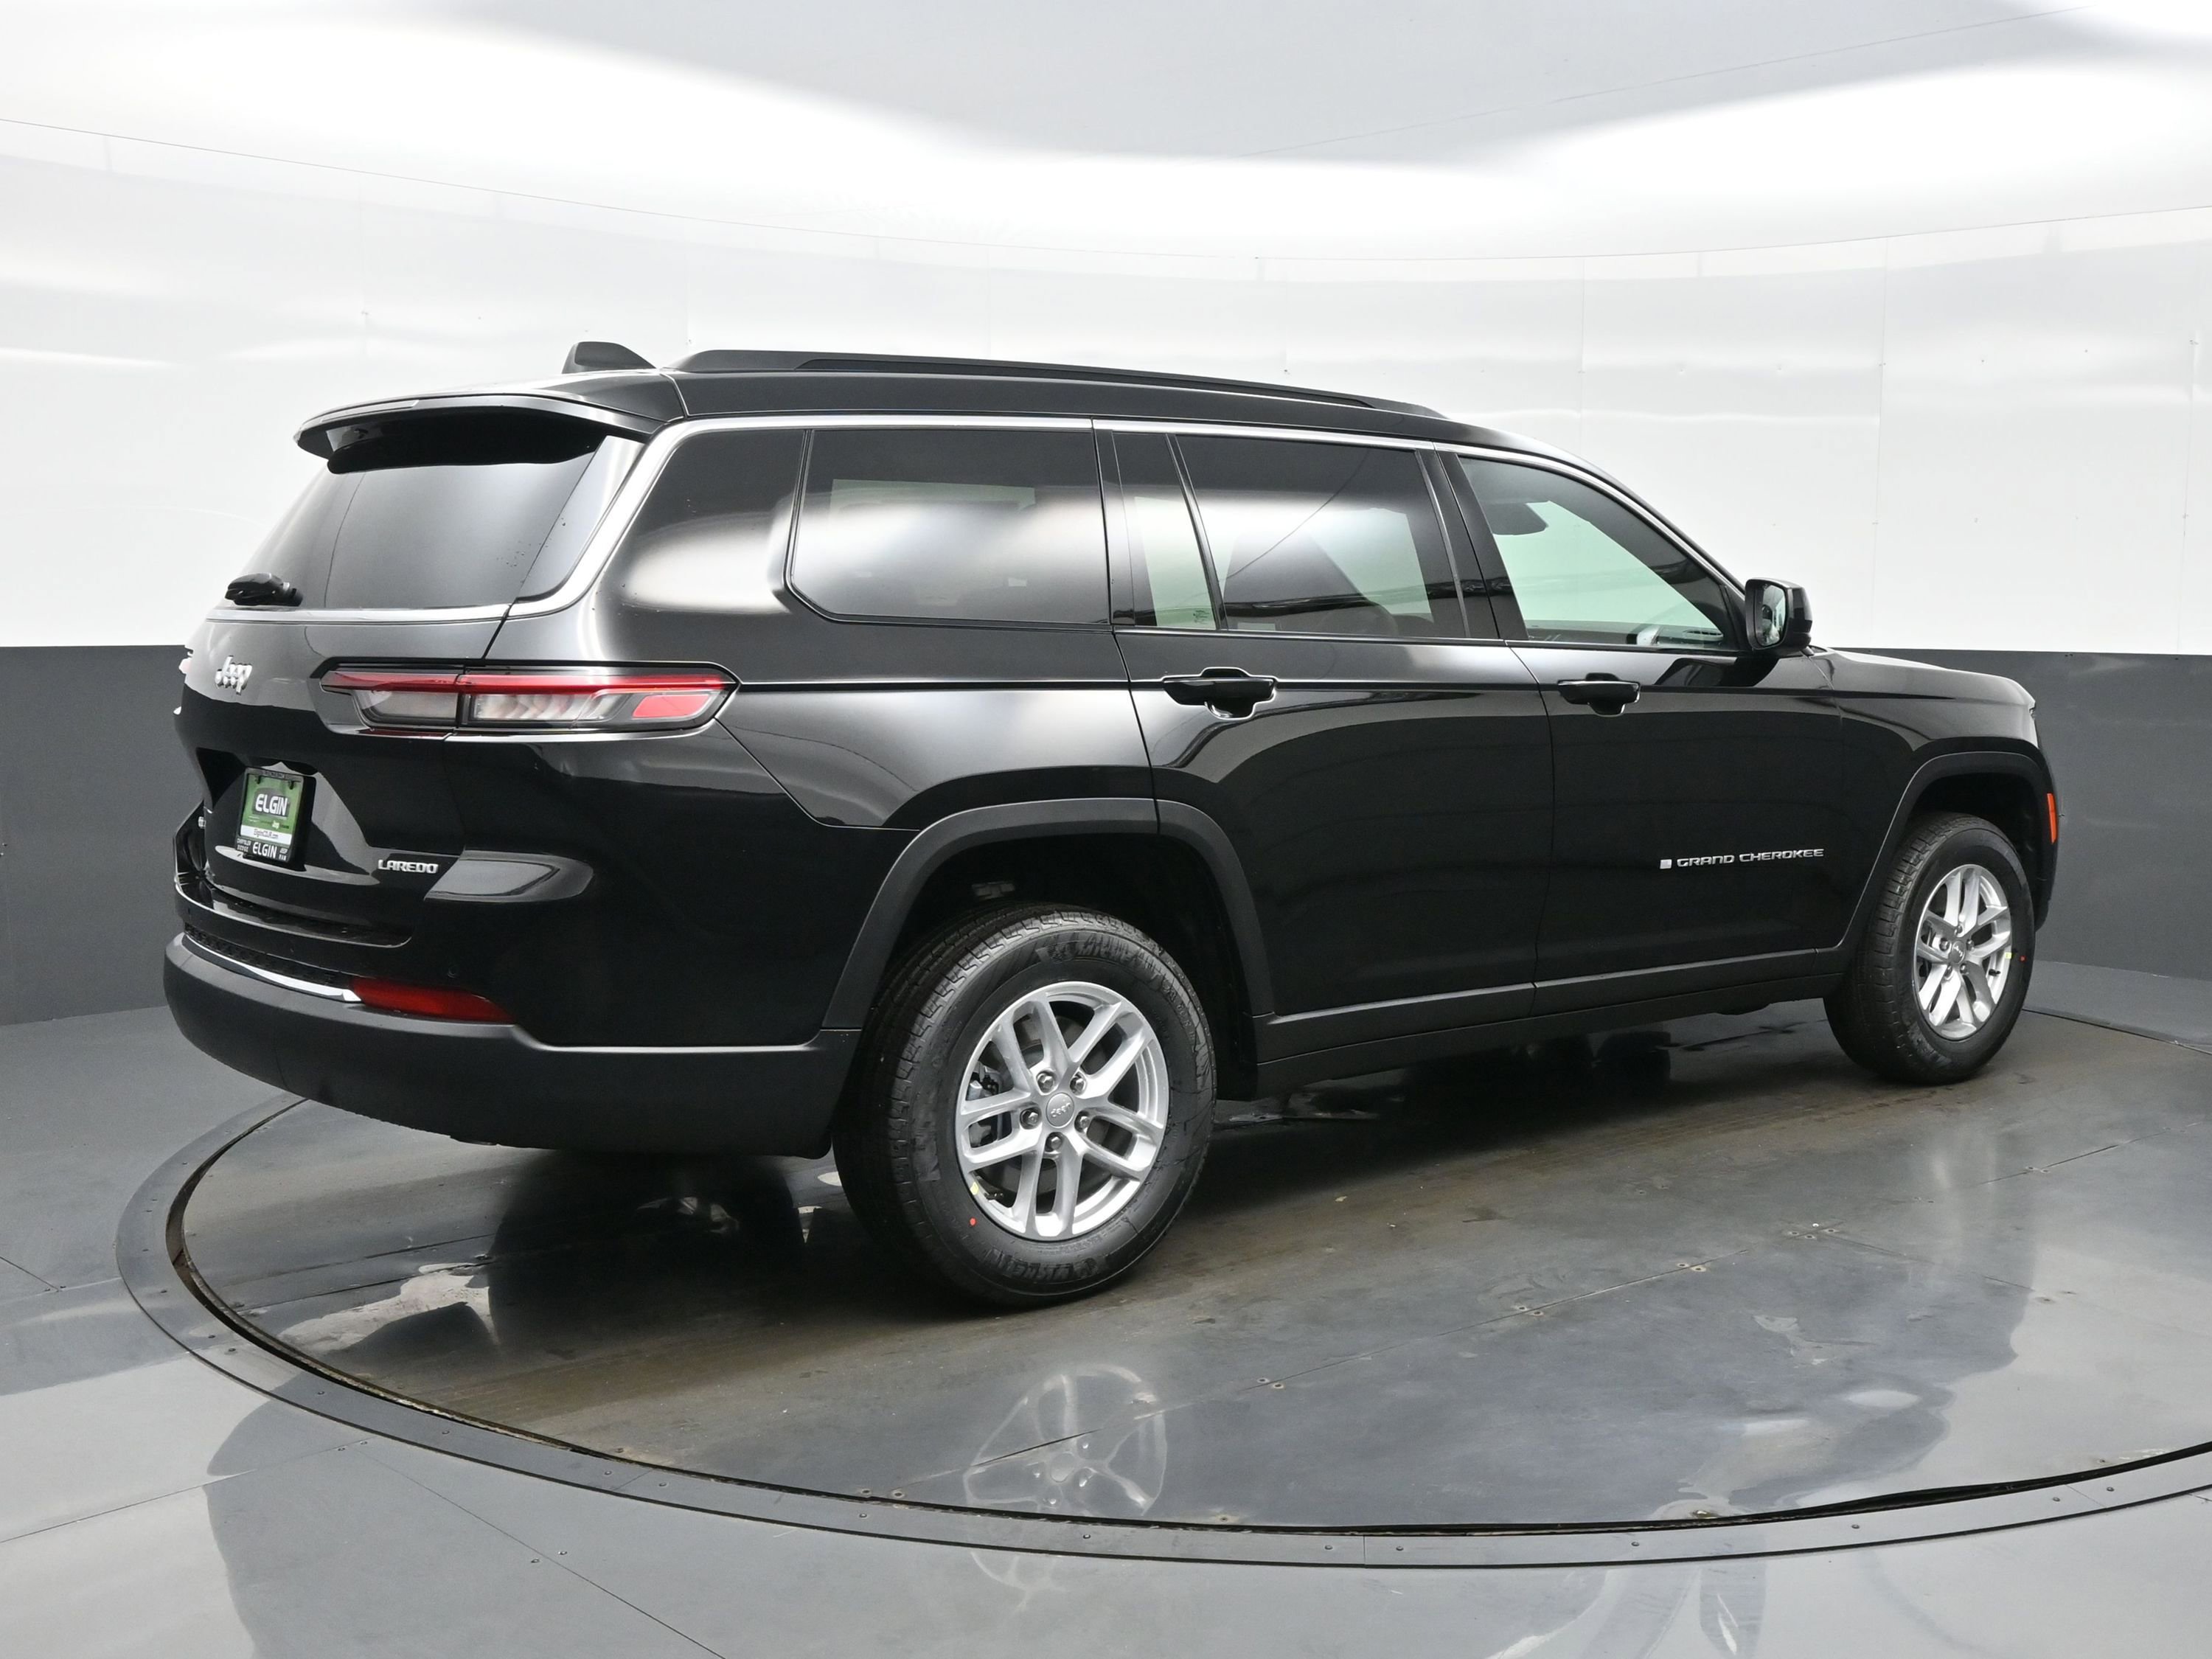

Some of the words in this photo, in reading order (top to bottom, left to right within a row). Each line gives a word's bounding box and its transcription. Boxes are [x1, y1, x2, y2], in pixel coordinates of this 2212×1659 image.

[215, 655, 252, 695] Jeep
[255, 793, 288, 816] ELGIN
[252, 842, 277, 859] ELGIN
[1677, 855, 1735, 867] GRAND
[1739, 849, 1824, 862] CHEROKEE
[378, 859, 439, 874] LAREDO
